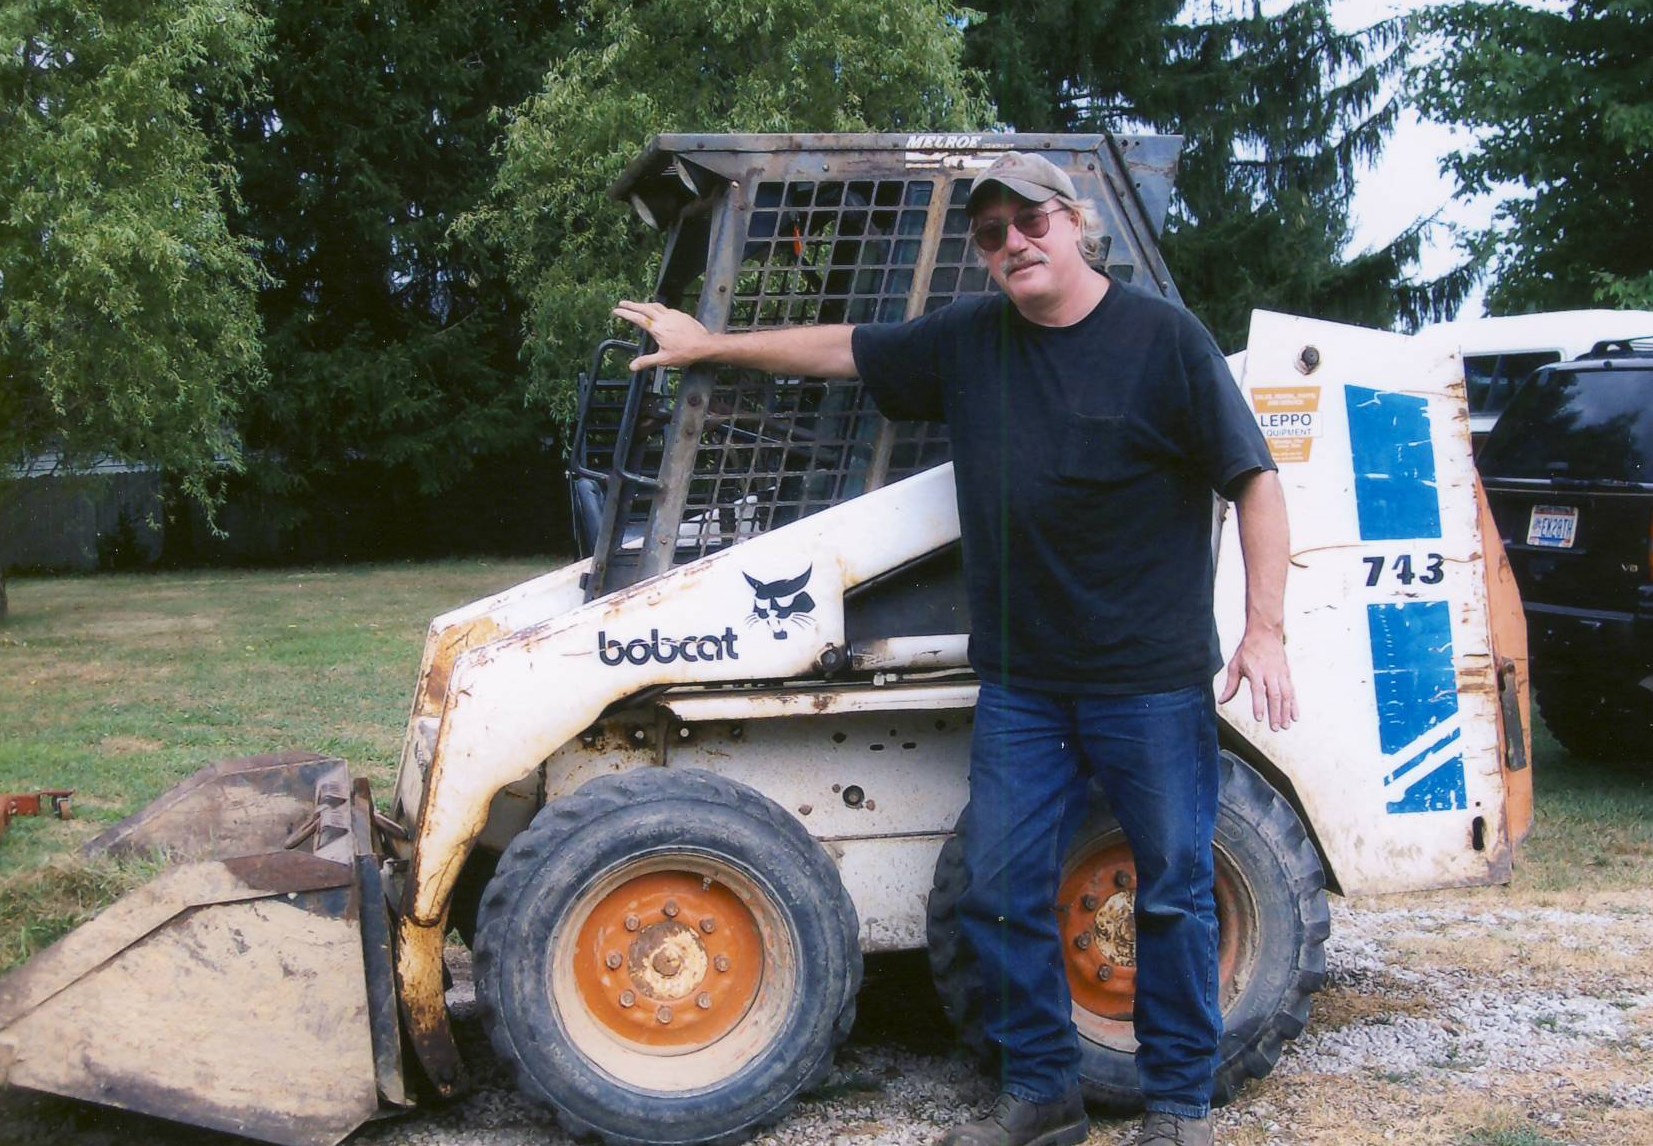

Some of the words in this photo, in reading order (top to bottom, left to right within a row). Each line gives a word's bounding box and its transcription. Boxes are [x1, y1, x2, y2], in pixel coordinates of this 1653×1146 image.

[906, 135, 982, 149] MELROE
[1260, 413, 1312, 427] LEPPO
[1363, 553, 1444, 586] 743
[598, 627, 739, 666] bobcat
